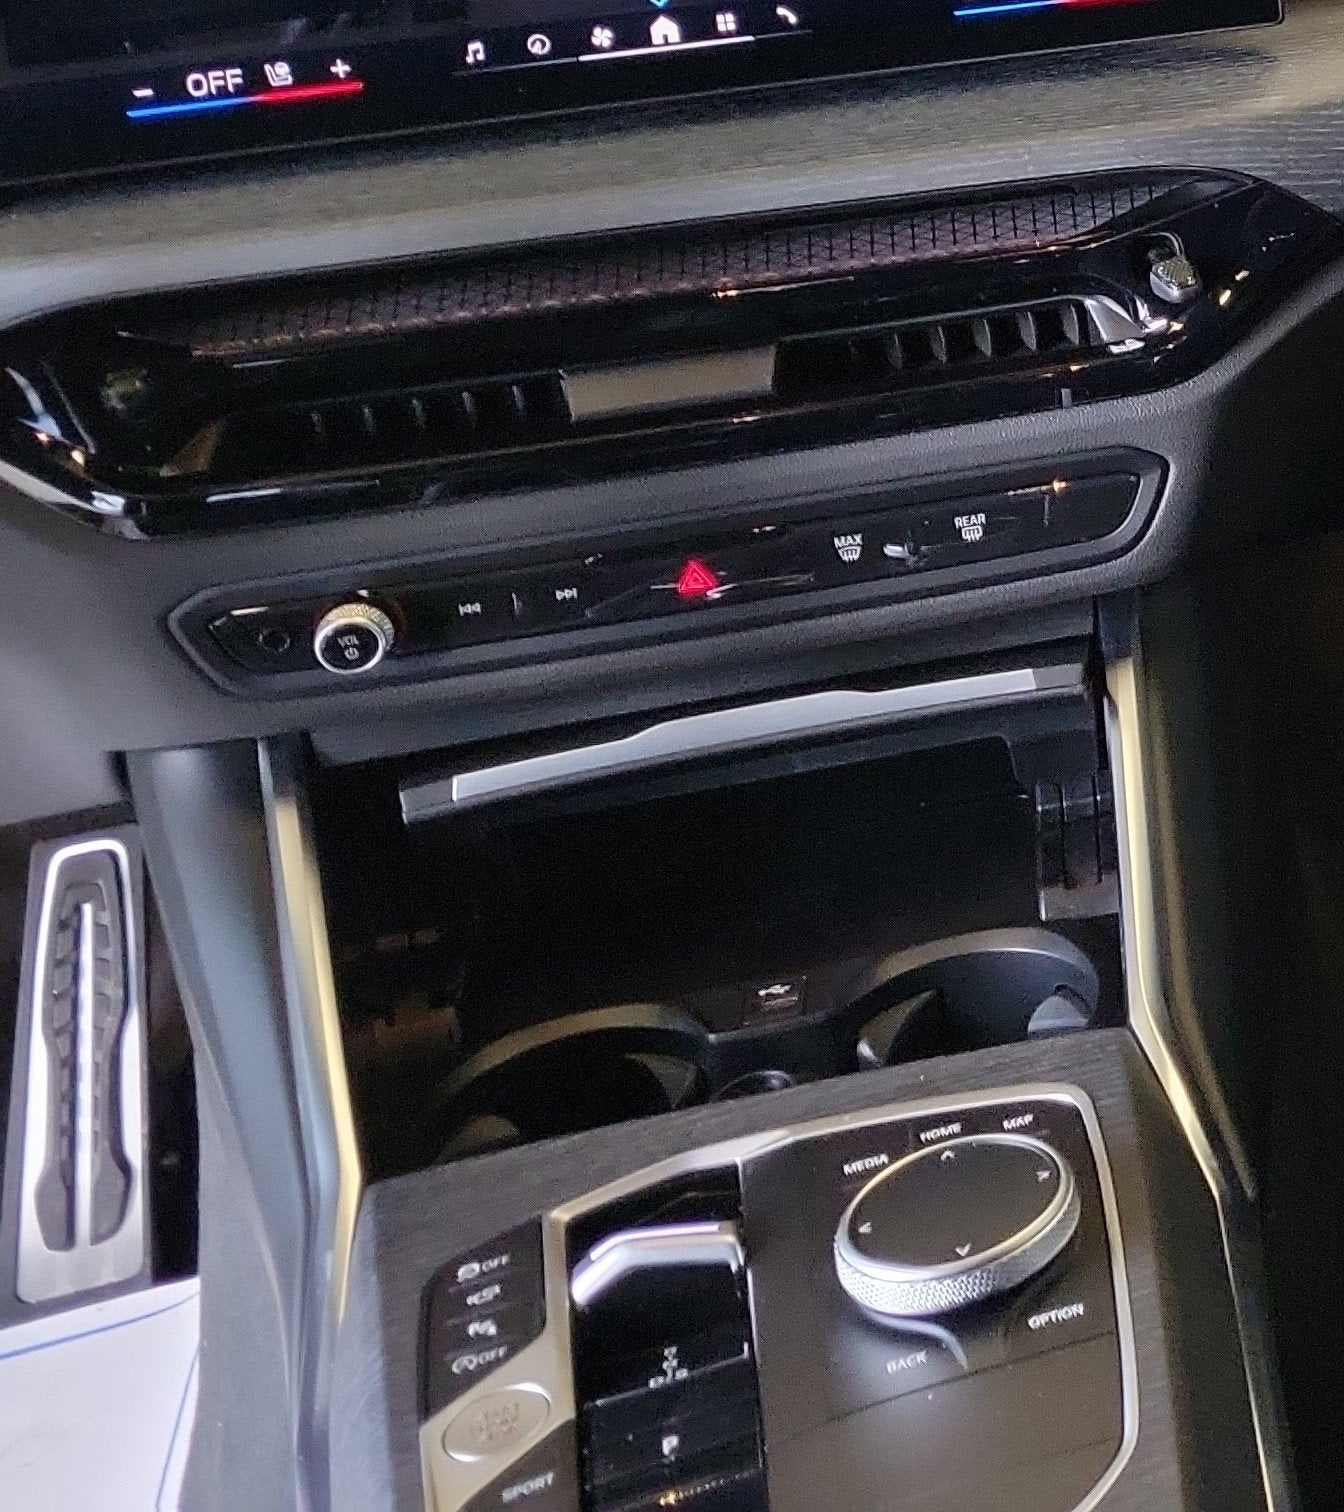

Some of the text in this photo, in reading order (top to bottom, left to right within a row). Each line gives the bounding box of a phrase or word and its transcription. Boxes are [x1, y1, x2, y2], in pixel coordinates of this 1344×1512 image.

[186, 67, 244, 97] OFF
[954, 513, 987, 529] REAR
[833, 533, 863, 548] MAX
[337, 635, 360, 648] VOL
[920, 1122, 963, 1143] HOME
[1002, 1113, 1034, 1131] MAP
[843, 1153, 889, 1175] MEDIA
[1027, 1302, 1085, 1330] OPTION
[886, 1350, 928, 1375] BACK
[502, 1472, 554, 1503] SPORT
